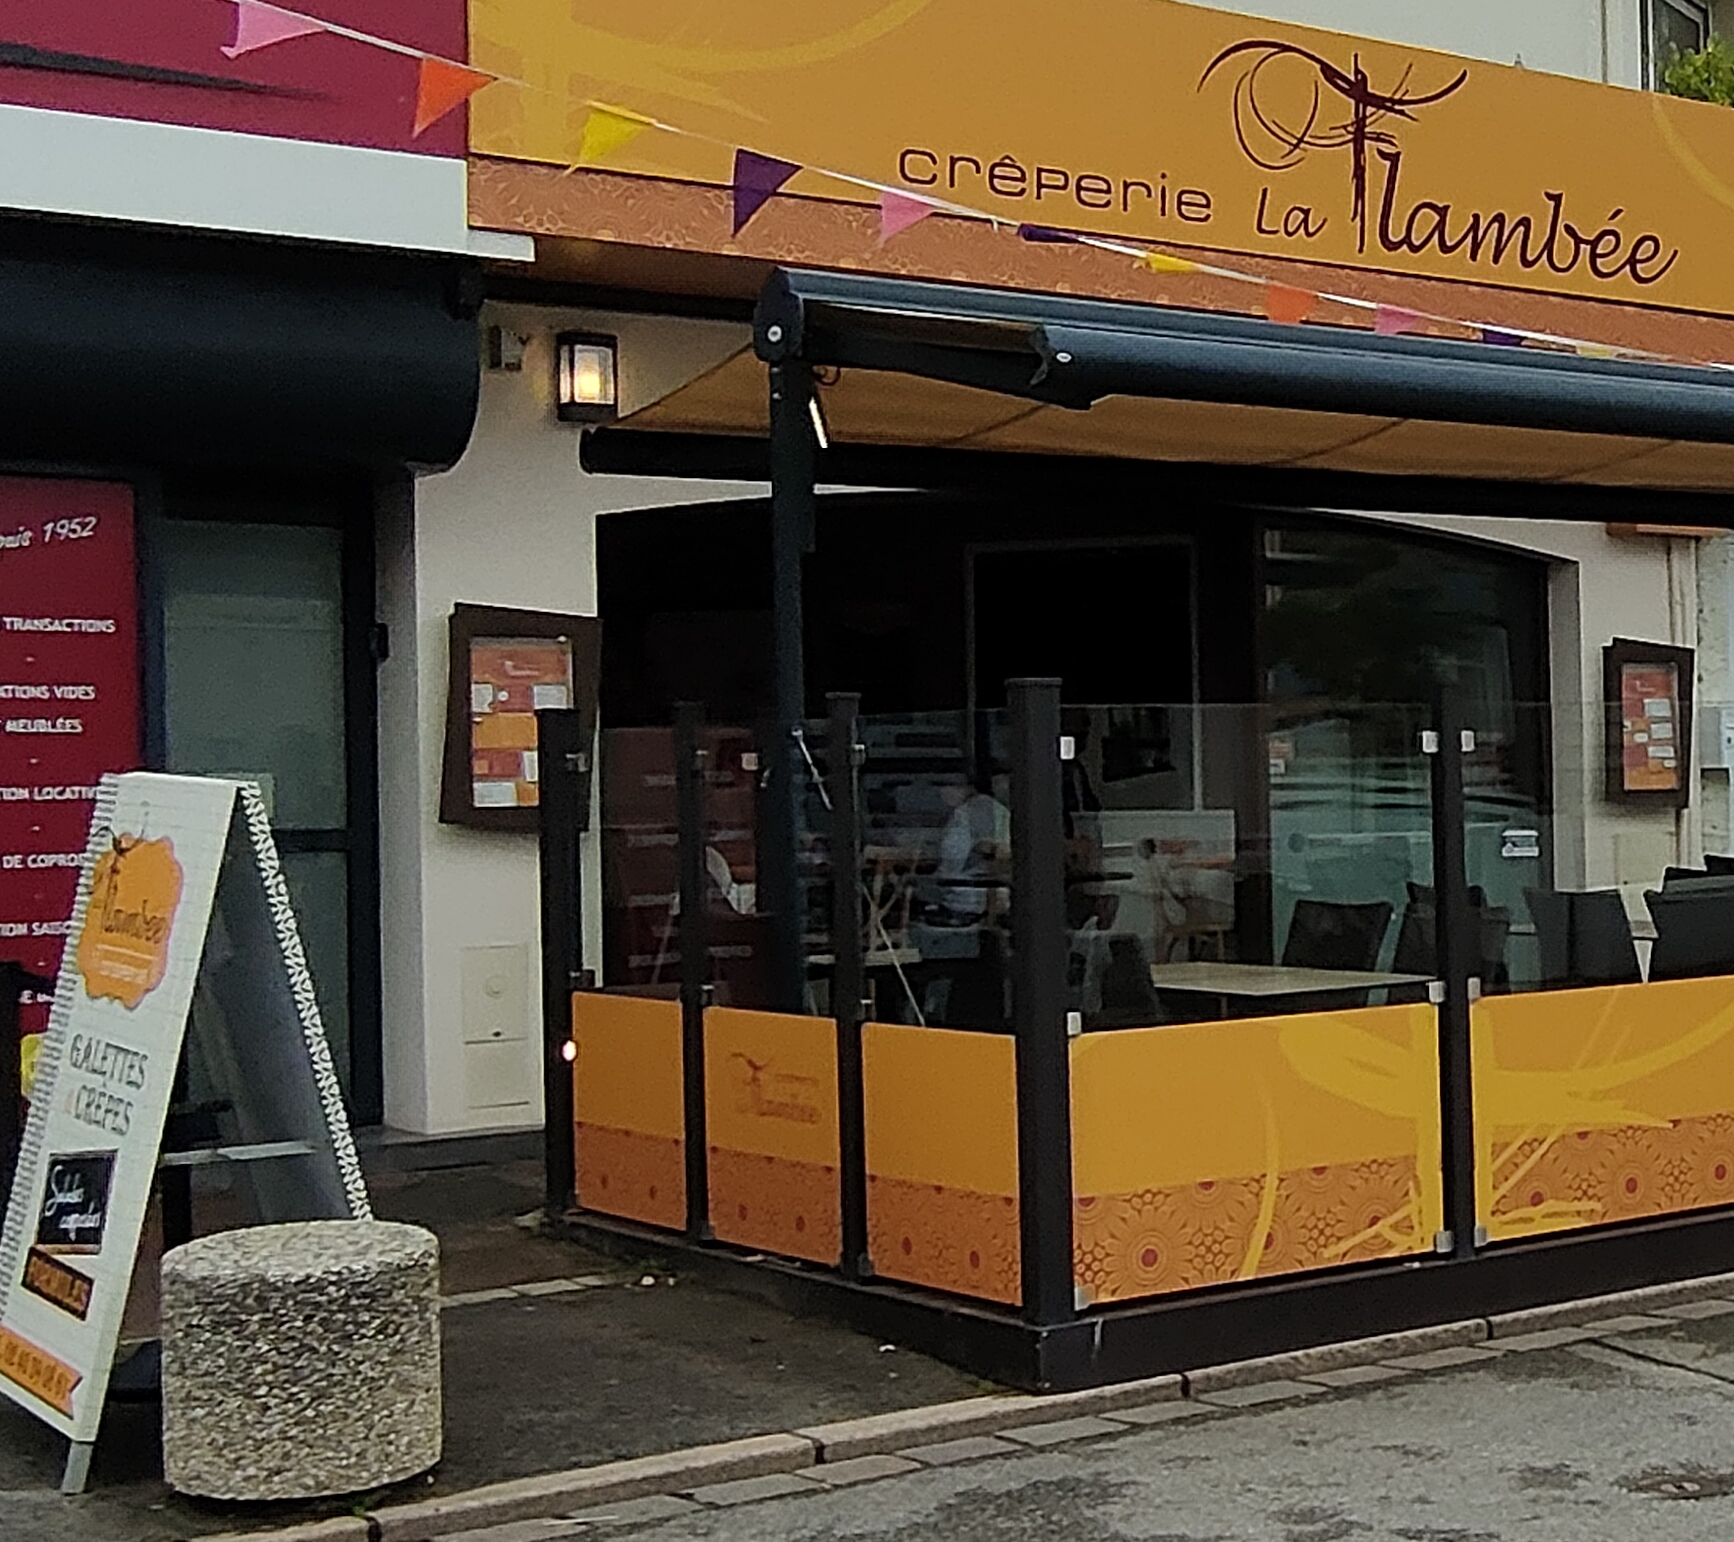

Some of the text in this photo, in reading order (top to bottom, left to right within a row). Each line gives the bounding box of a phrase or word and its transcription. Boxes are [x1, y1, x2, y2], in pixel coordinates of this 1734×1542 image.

[898, 41, 1680, 287] crêperie La Flambée
[43, 516, 98, 543] 1952
[2, 616, 117, 633] TRANSACTIONS
[52, 685, 96, 700] VIDES
[5, 716, 83, 733] MEUBLÉES
[2, 855, 24, 869] DE
[69, 1032, 149, 1091] GALETTES
